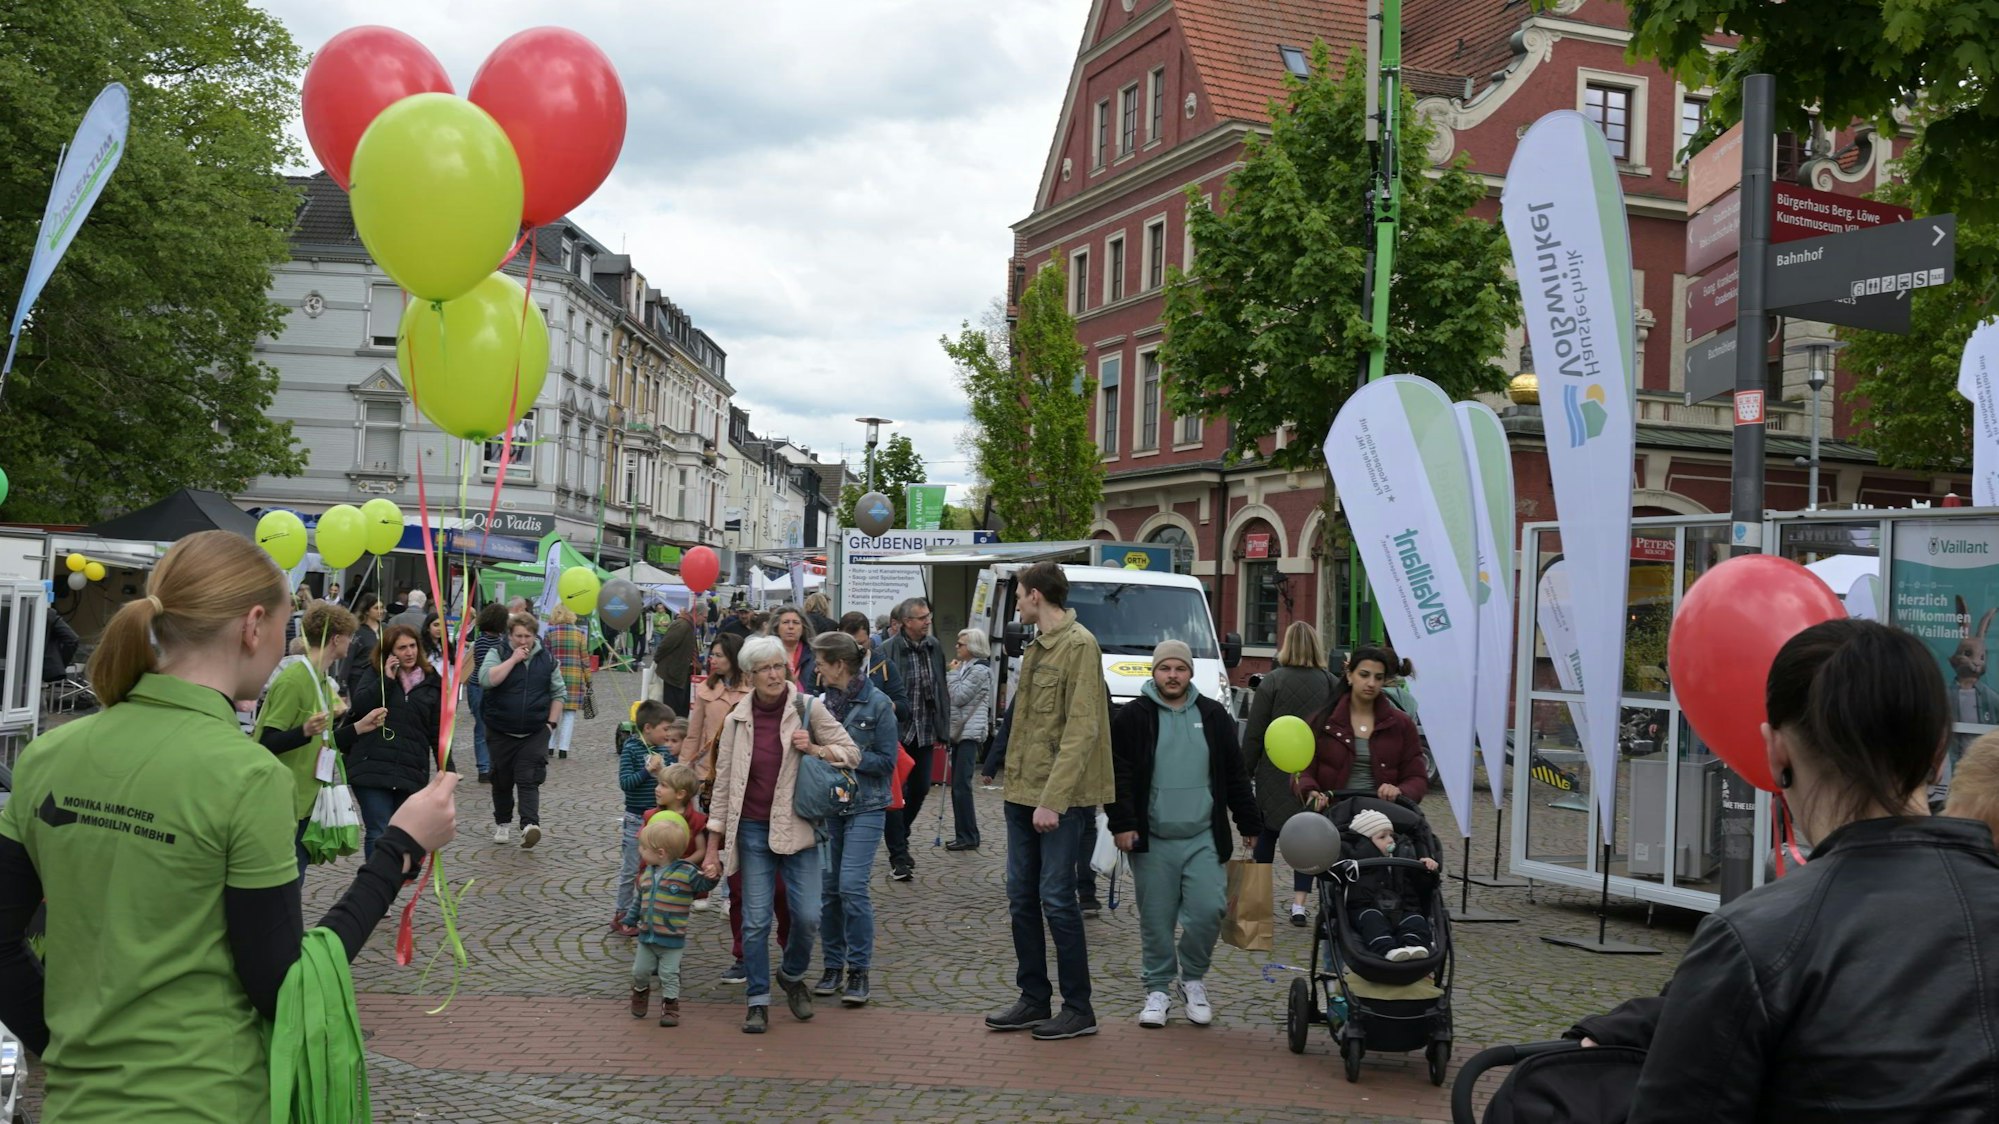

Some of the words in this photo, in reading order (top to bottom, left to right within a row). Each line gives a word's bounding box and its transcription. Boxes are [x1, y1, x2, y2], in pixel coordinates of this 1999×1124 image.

[57, 133, 114, 224] INSEKTUM
[1776, 193, 1830, 215] Bürgerhaus
[1831, 204, 1855, 221] Berg.
[1857, 209, 1881, 224] Löwe
[1776, 210, 1843, 234] Kunstmuseum
[1776, 246, 1824, 267] Bahnhof
[472, 512, 503, 532] Quo
[506, 514, 542, 532] Vadis
[1635, 537, 1676, 550] PETERS
[1940, 540, 1989, 554] Vaillant
[1127, 556, 1147, 565] ORTH
[1897, 594, 1948, 607] Herzlich
[1897, 608, 1972, 623] Willkommen
[1917, 625, 1969, 639] Vaillant!
[62, 796, 102, 812] MONIKA
[1734, 802, 1746, 810] THE
[133, 825, 166, 842] GMBH
